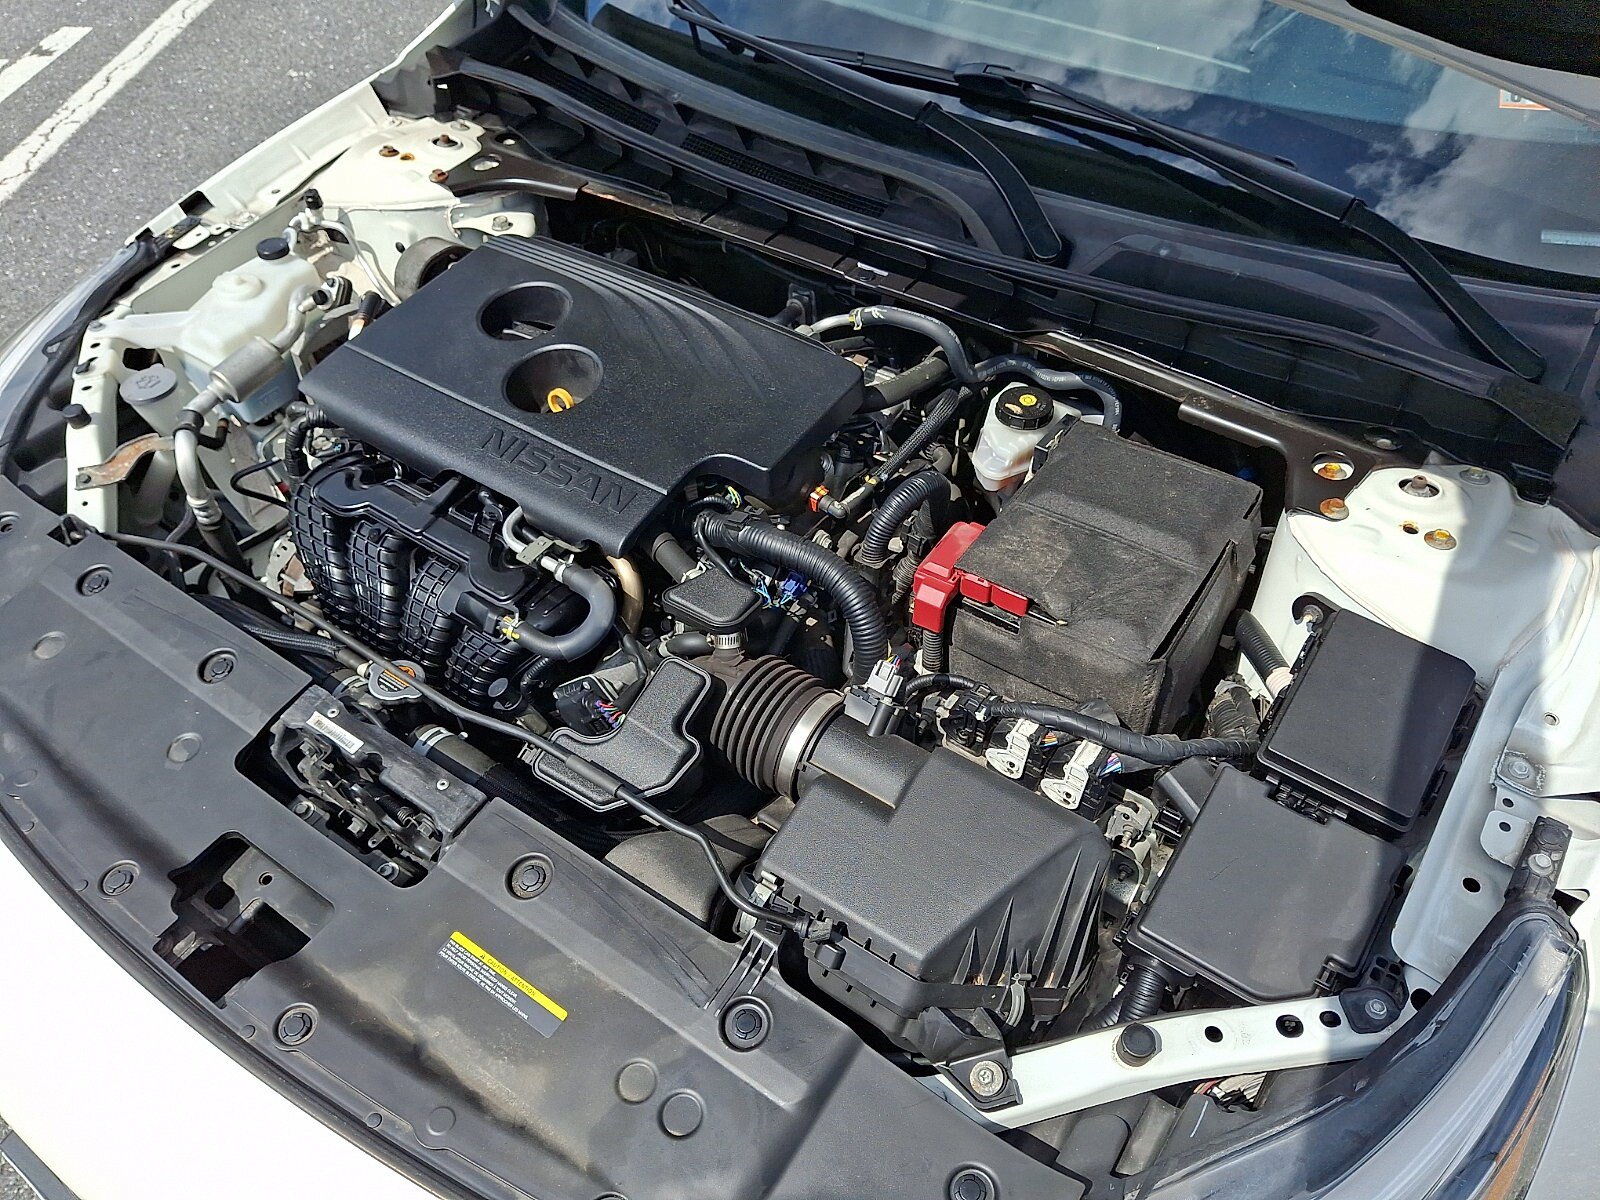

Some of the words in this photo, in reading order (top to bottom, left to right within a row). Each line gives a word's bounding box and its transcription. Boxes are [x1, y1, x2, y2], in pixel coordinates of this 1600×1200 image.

[480, 427, 637, 515] NISSAN
[487, 958, 507, 975] CAUTION
[510, 976, 536, 996] ATTENTION
